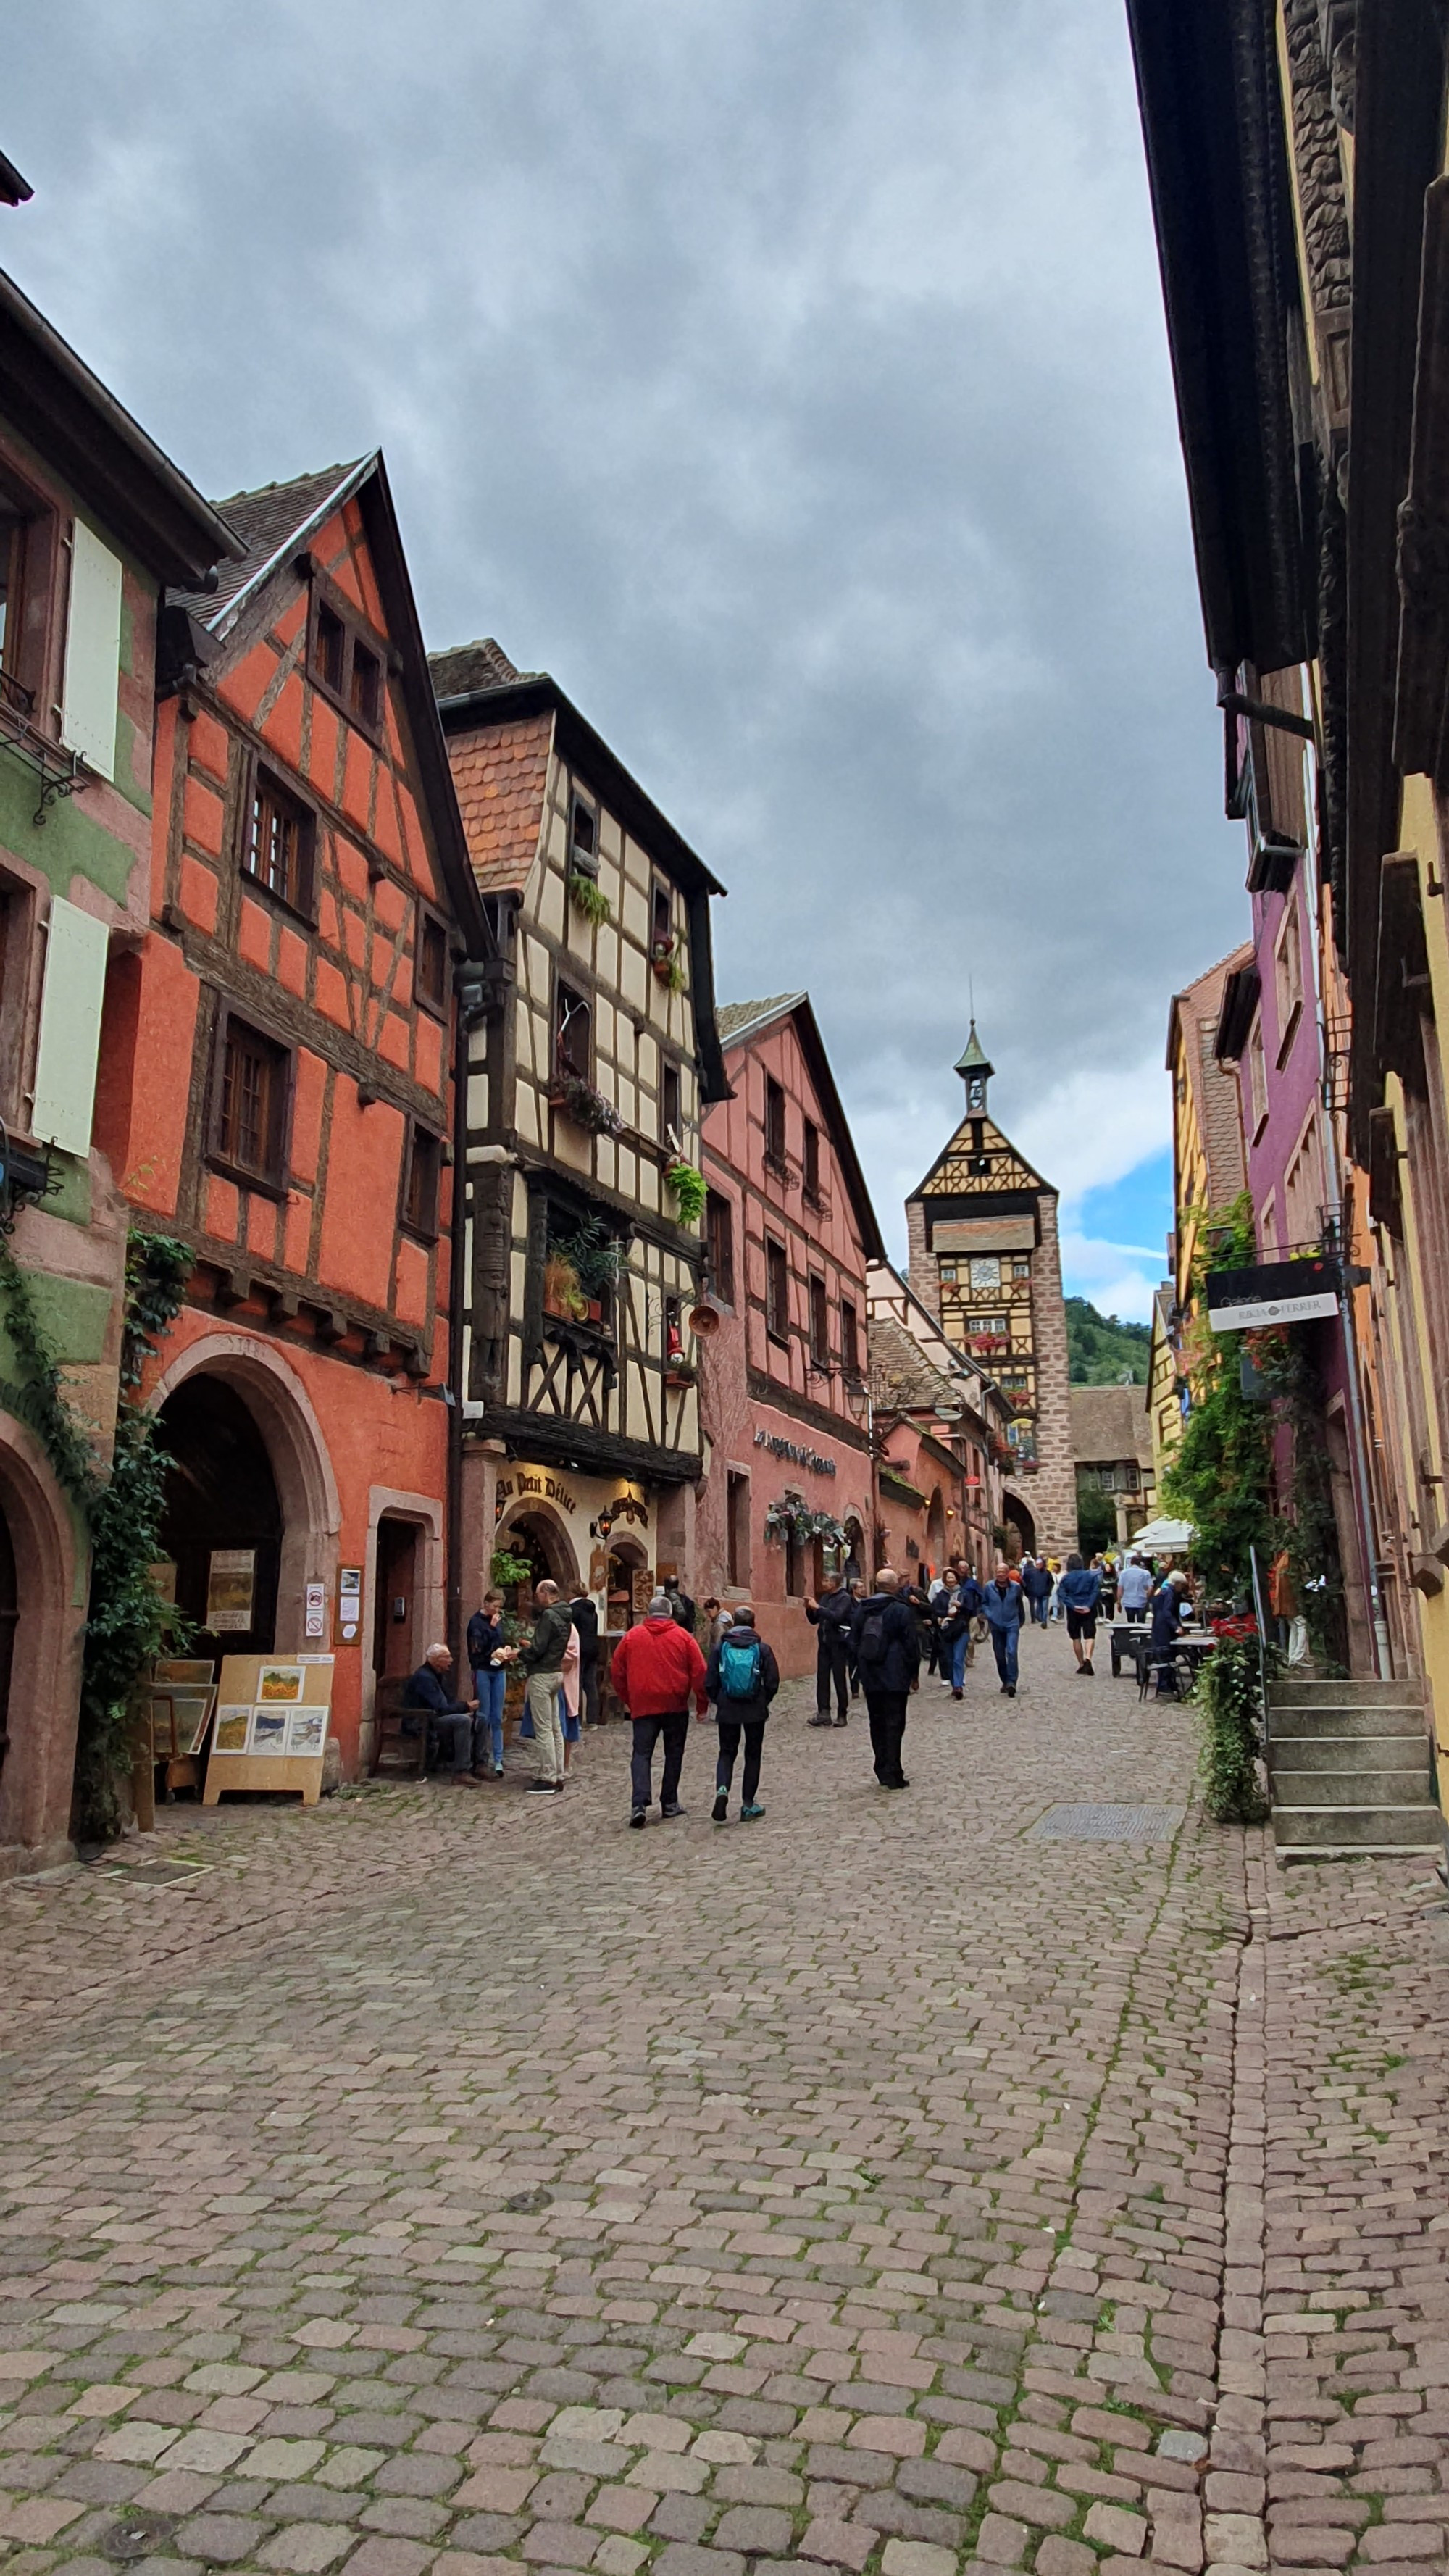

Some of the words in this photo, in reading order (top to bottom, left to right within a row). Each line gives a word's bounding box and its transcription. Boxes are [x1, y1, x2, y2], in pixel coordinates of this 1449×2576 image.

[1220, 1294, 1262, 1307] Galerie
[496, 1480, 514, 1497] Au
[516, 1472, 543, 1496] Petit
[544, 1475, 576, 1514] Délice
